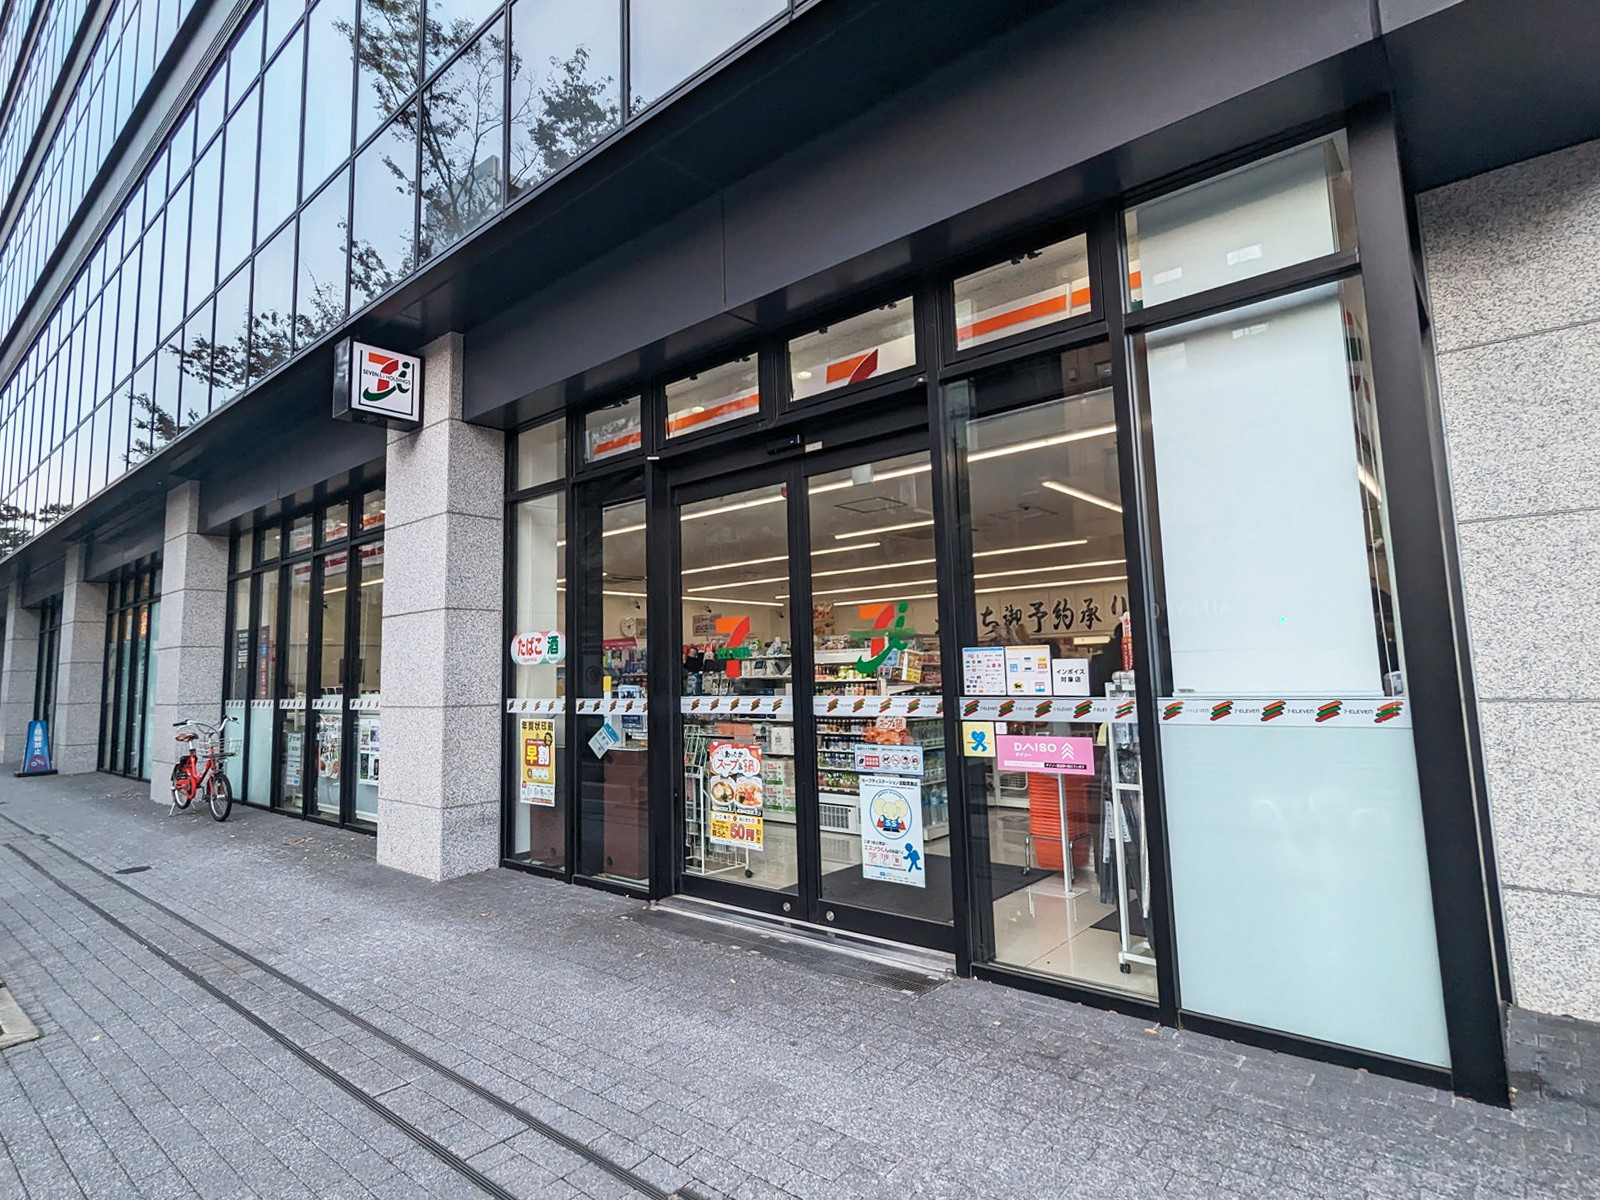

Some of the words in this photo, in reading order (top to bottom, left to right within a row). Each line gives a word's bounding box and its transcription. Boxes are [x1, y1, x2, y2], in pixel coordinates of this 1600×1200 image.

[517, 636, 543, 657] たばこ
[547, 635, 559, 655] 酒
[526, 744, 550, 766] 早割
[1014, 742, 1057, 753] DAISO
